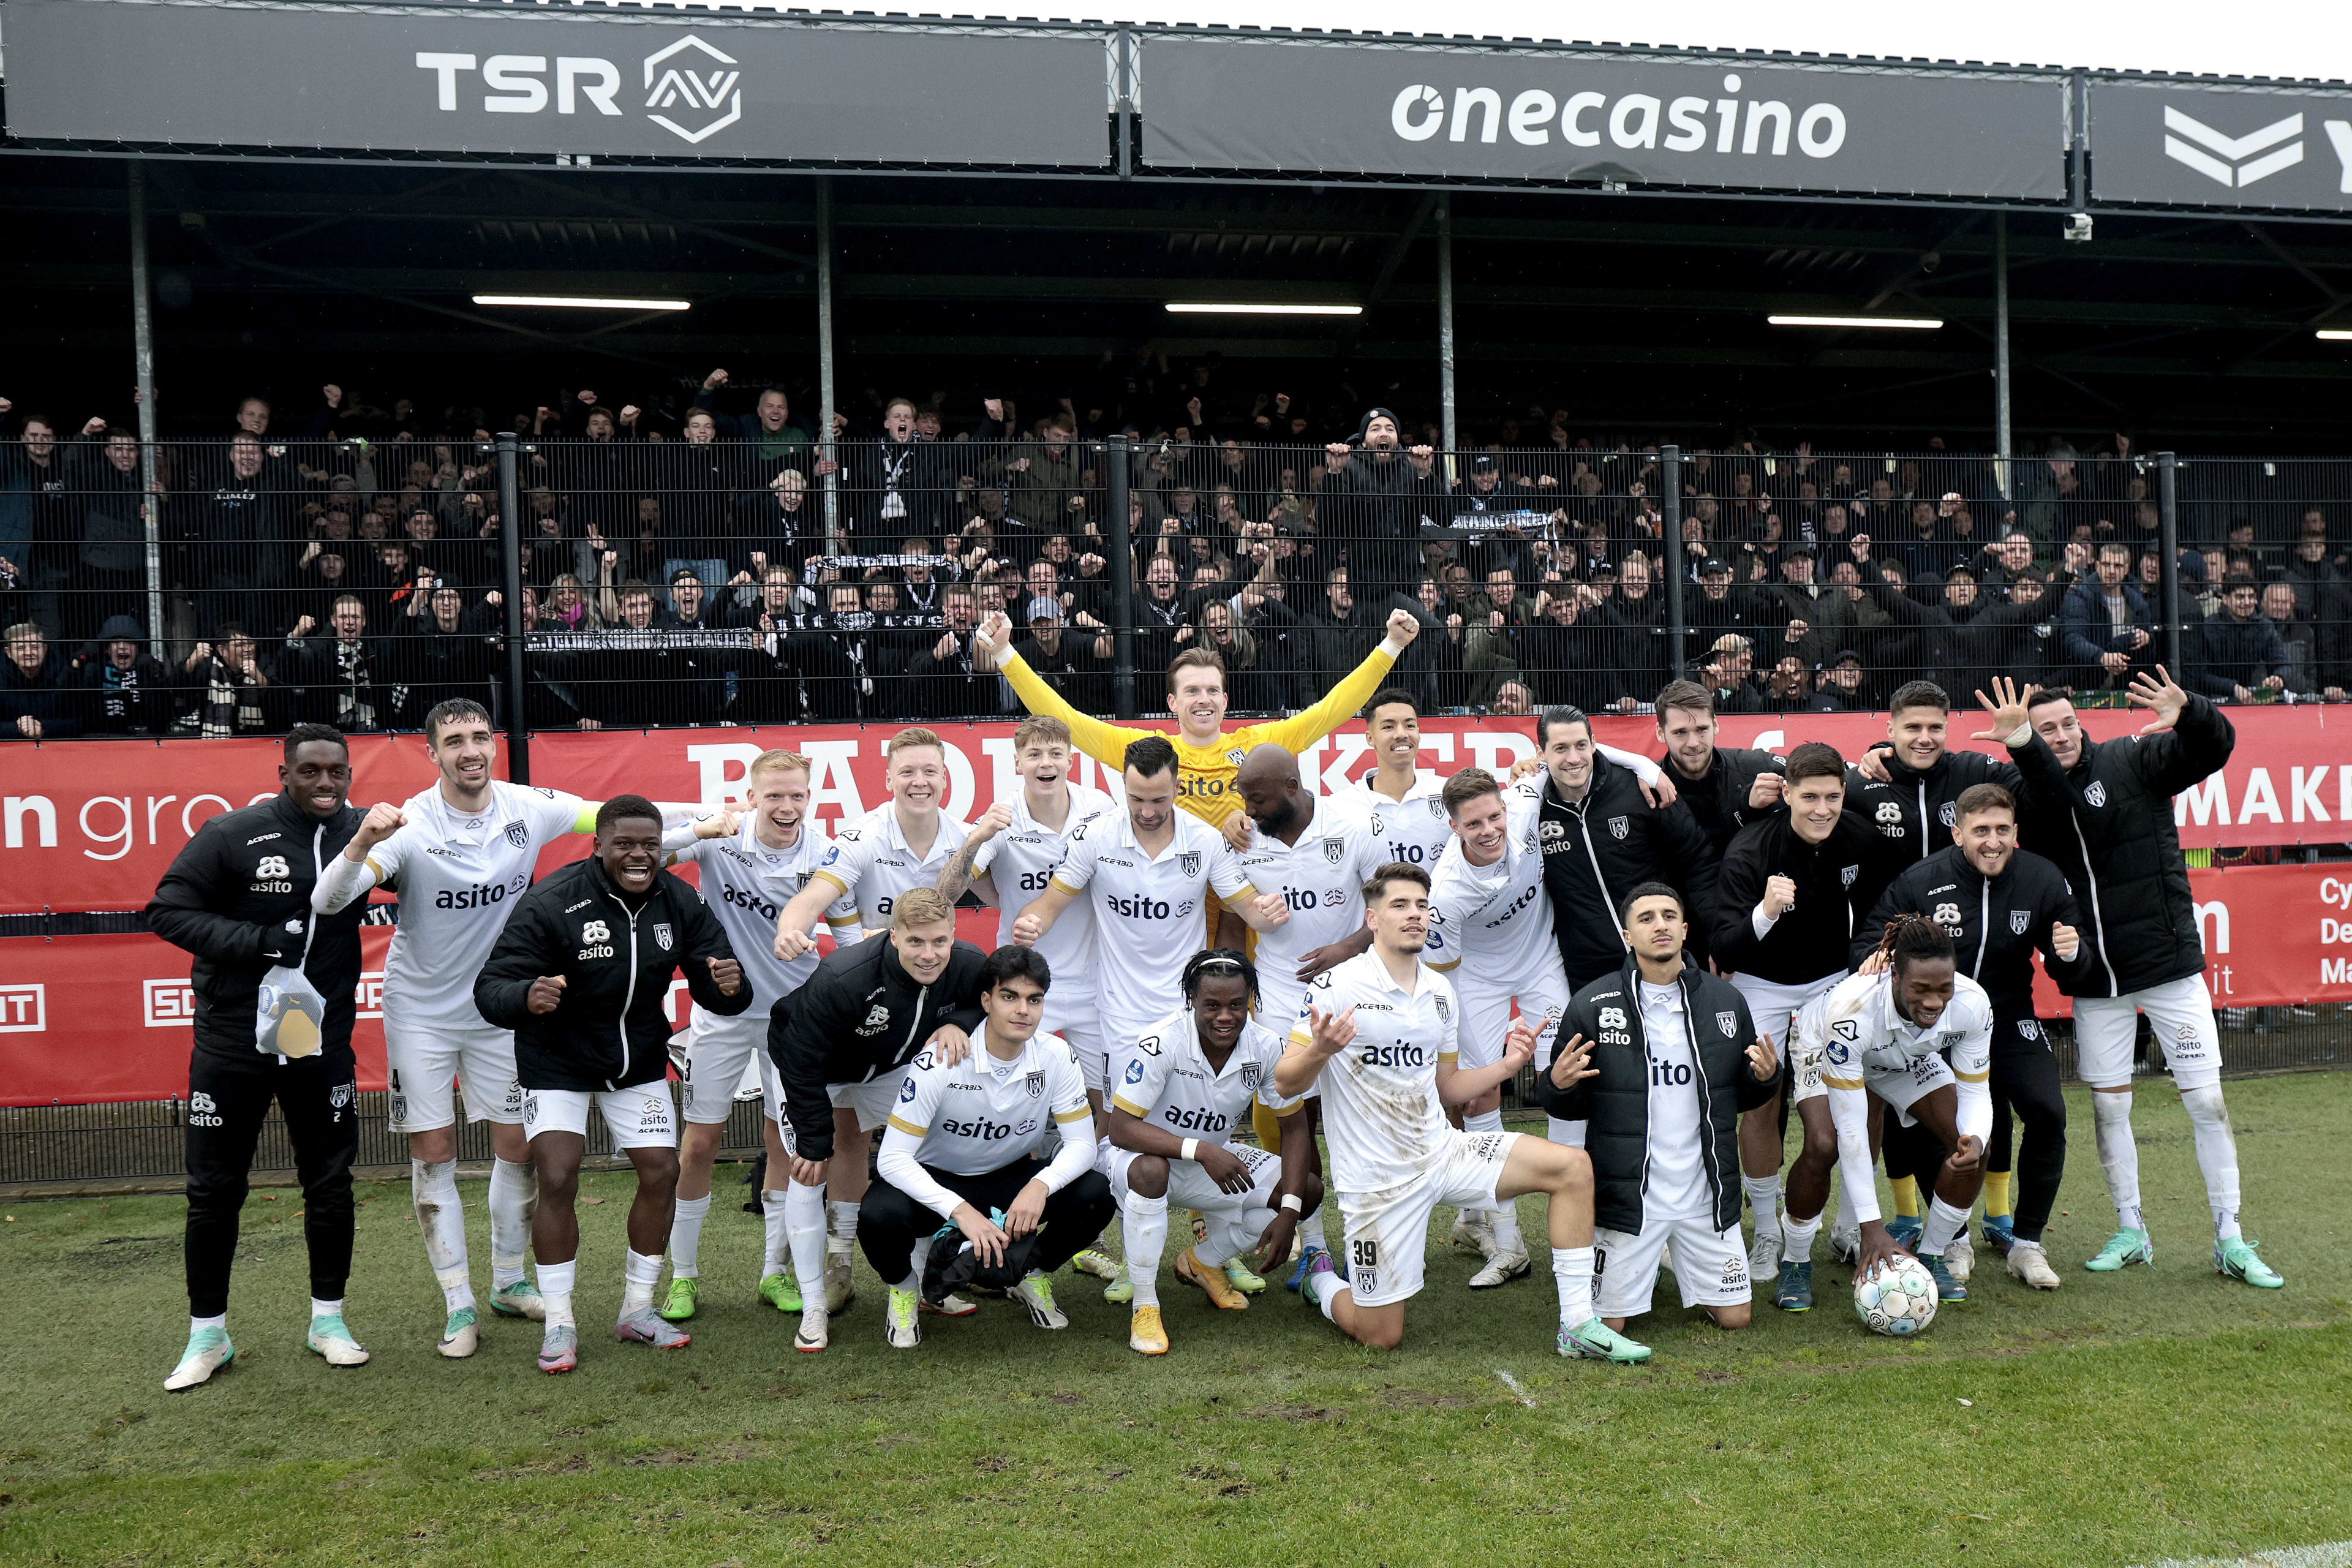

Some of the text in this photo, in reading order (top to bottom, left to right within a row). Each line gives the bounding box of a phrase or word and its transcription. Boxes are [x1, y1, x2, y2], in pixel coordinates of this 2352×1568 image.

[415, 51, 623, 116] TSR
[1392, 74, 1847, 159] onecasino
[1178, 774, 1224, 796] sito
[79, 793, 280, 861] gro
[1875, 823, 1905, 837] sito
[246, 832, 282, 846] ACERBIS
[1541, 840, 1571, 855] asito
[719, 846, 753, 868] ACERBIS
[1097, 856, 1134, 867] ACERBIS
[1242, 857, 1274, 866] ACERBIS
[1389, 841, 1423, 864] ito
[250, 880, 292, 894] asito
[1020, 864, 1054, 891] asi
[435, 883, 505, 910] asito
[1280, 886, 1317, 911] ito
[1928, 884, 1957, 896] ACERBIS
[565, 899, 592, 913] ACERBIS
[723, 883, 777, 921] asito
[1107, 894, 1170, 919] asito
[1485, 885, 1537, 929] asito
[578, 943, 614, 960] asito
[1589, 991, 1621, 1003] ACERBIS
[855, 1023, 889, 1036] asito
[1361, 1039, 1423, 1067] asito
[2176, 1041, 2201, 1050] asito
[393, 1069, 401, 1092] 4
[685, 1058, 692, 1082] 3
[1652, 1057, 1692, 1086] ito
[1914, 1062, 1938, 1079] asito
[1917, 1070, 1945, 1086] ACERBIS
[947, 1082, 982, 1091] ACERBIS
[506, 1094, 521, 1102] asi
[189, 1113, 223, 1126] asito
[333, 1112, 341, 1122] 2
[641, 1114, 668, 1125] asito
[942, 1116, 1011, 1140] asito
[1164, 1105, 1226, 1132] asito
[1478, 1134, 1495, 1157] asito
[1354, 1240, 1377, 1266] 39
[1594, 1246, 1606, 1275] 0
[1722, 1273, 1746, 1284] asito
